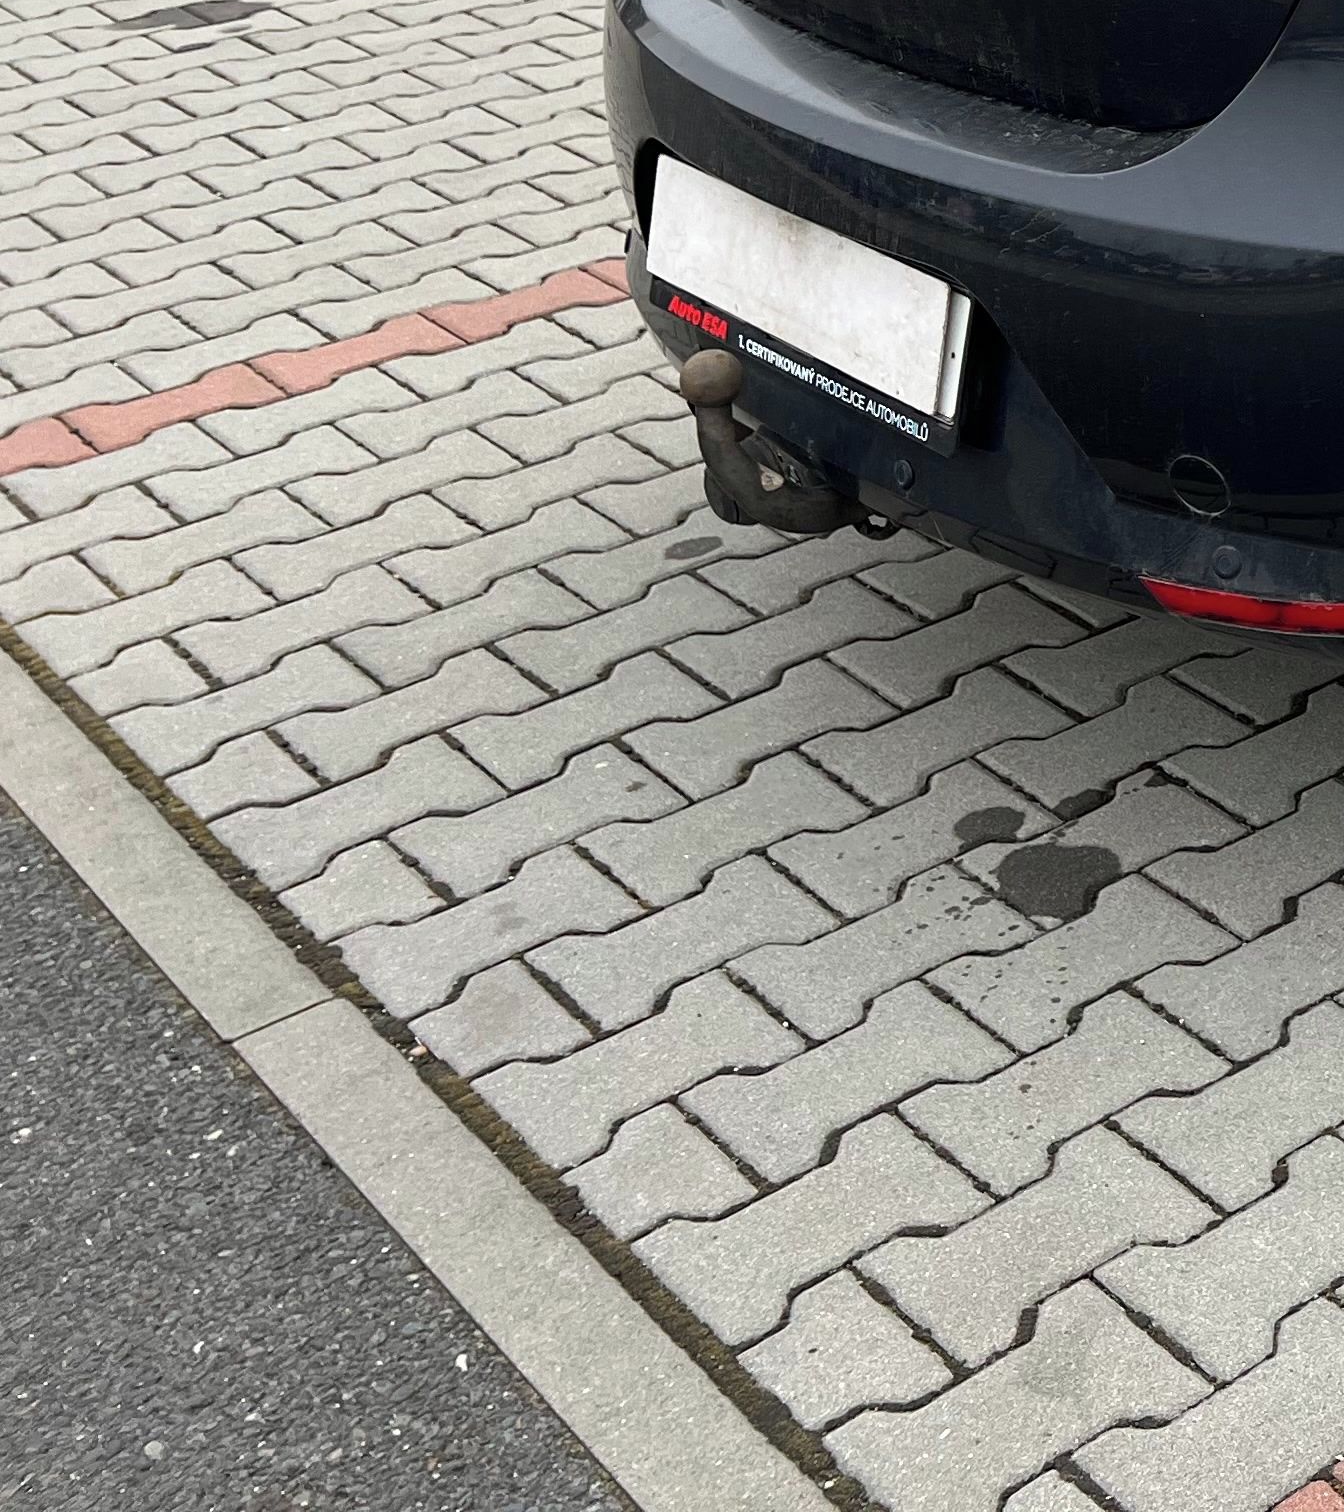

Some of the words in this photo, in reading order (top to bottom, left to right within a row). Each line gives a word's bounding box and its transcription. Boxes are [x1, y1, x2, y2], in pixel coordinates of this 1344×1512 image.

[701, 311, 728, 340] ESA
[738, 334, 745, 350] 1.
[746, 339, 816, 385] CERTIFIKOVANÝ
[815, 373, 866, 411] PRODEJCE
[865, 398, 929, 443] AUTOMOBILŮ
